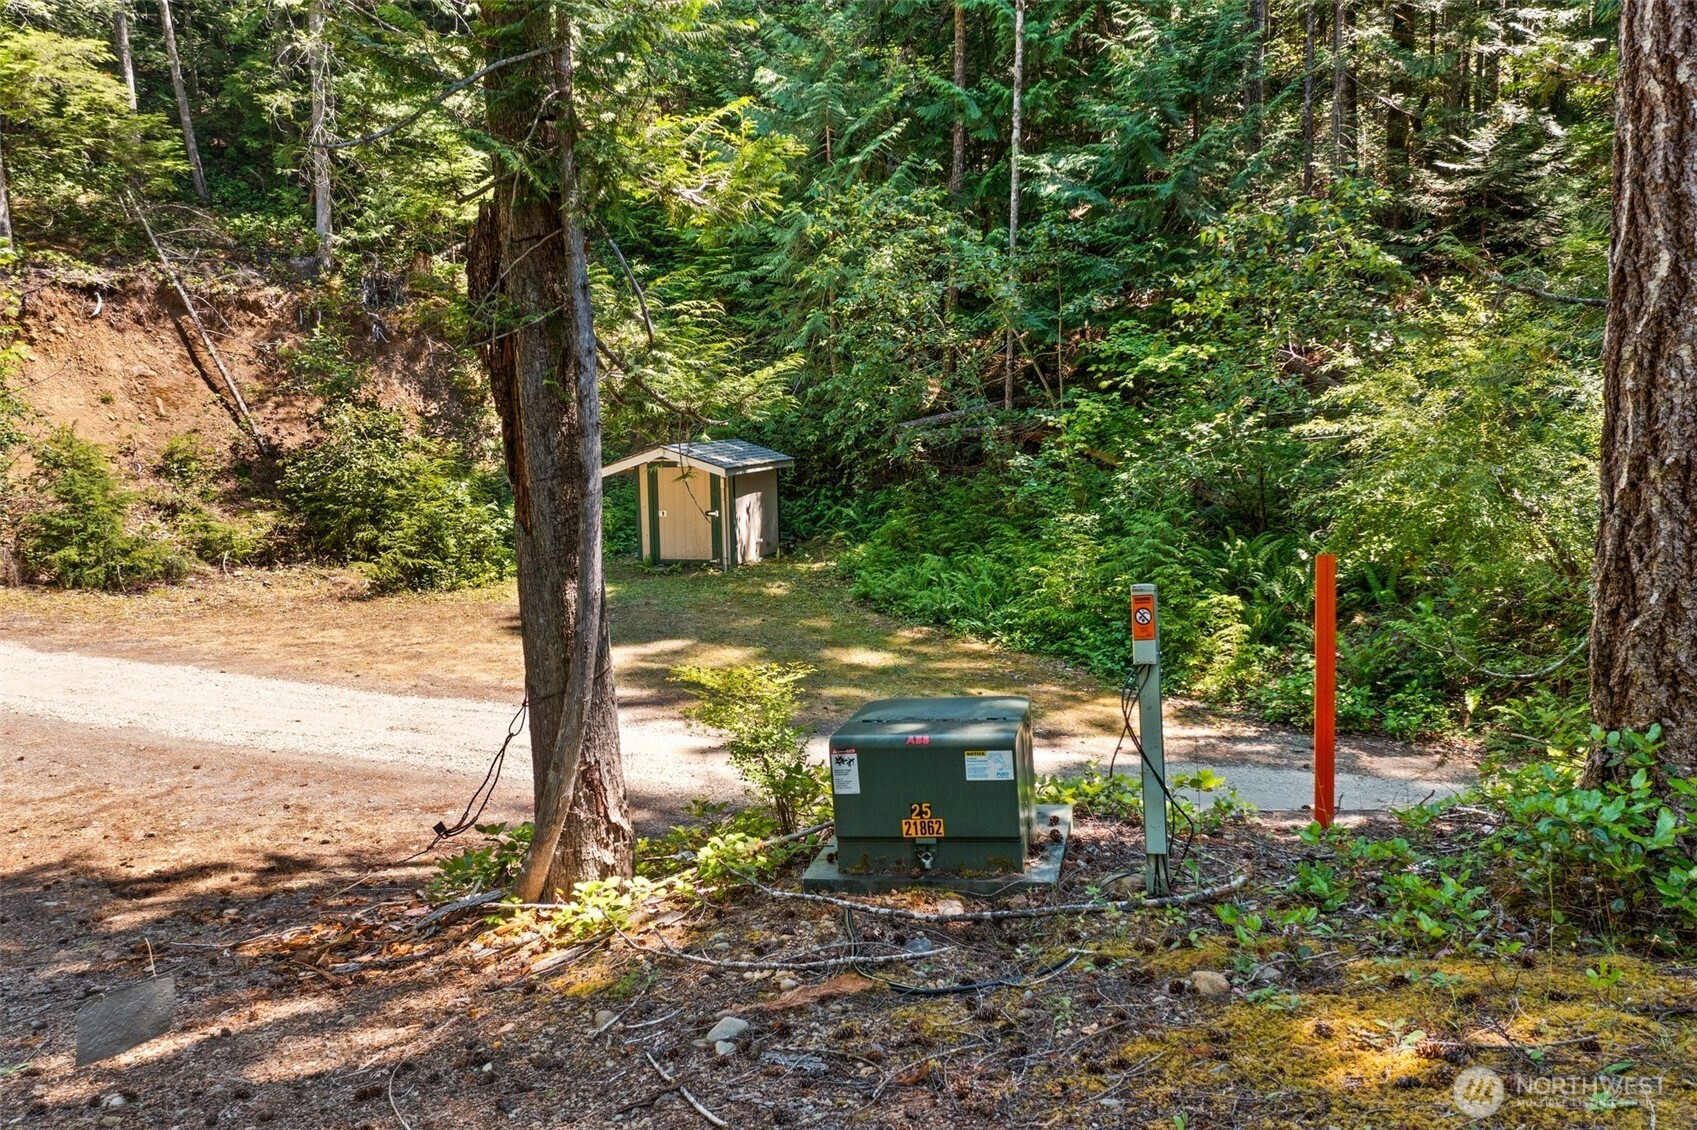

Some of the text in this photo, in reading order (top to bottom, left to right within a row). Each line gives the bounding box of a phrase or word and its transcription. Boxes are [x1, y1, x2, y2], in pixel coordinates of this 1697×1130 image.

[906, 735, 930, 745] ABB
[911, 803, 931, 819] 25
[904, 820, 943, 836] 21862
